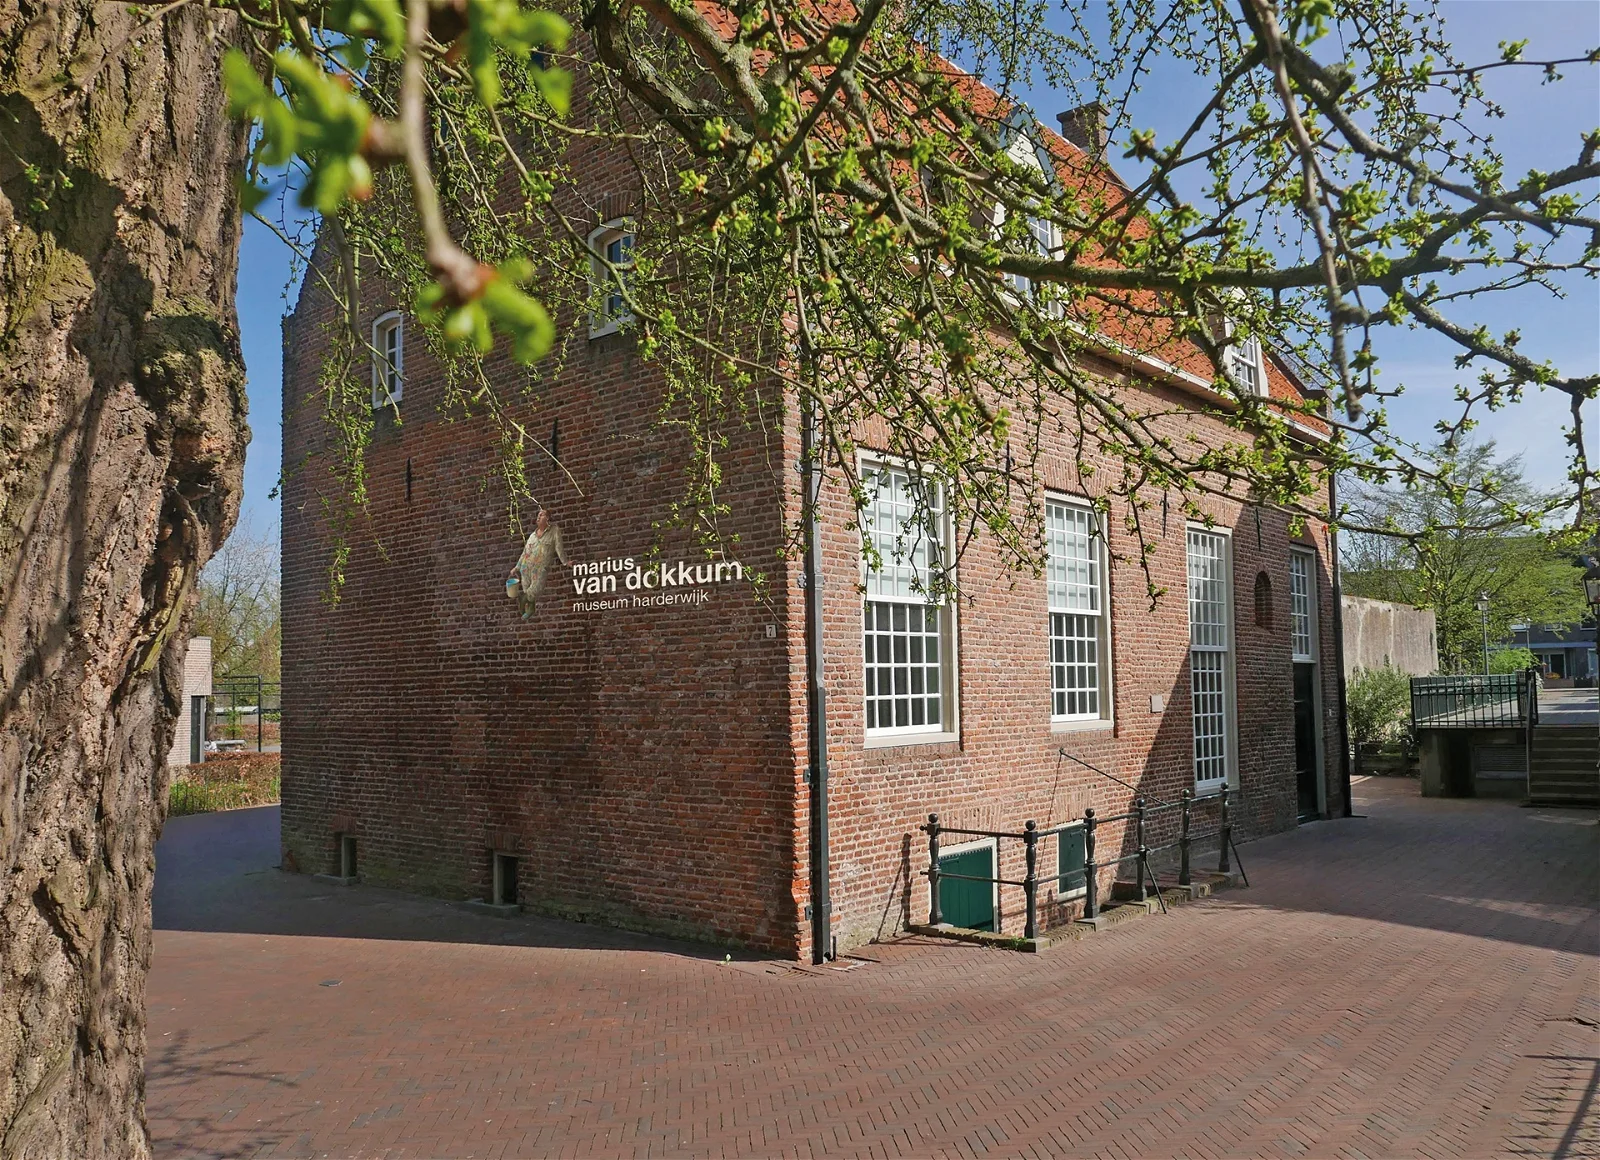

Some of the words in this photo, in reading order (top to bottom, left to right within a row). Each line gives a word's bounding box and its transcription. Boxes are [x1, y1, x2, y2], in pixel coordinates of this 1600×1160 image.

[572, 557, 635, 577] marius
[572, 574, 617, 595] van
[625, 560, 743, 590] dokkum
[573, 598, 629, 612] museum
[632, 590, 709, 608] harderwijk
